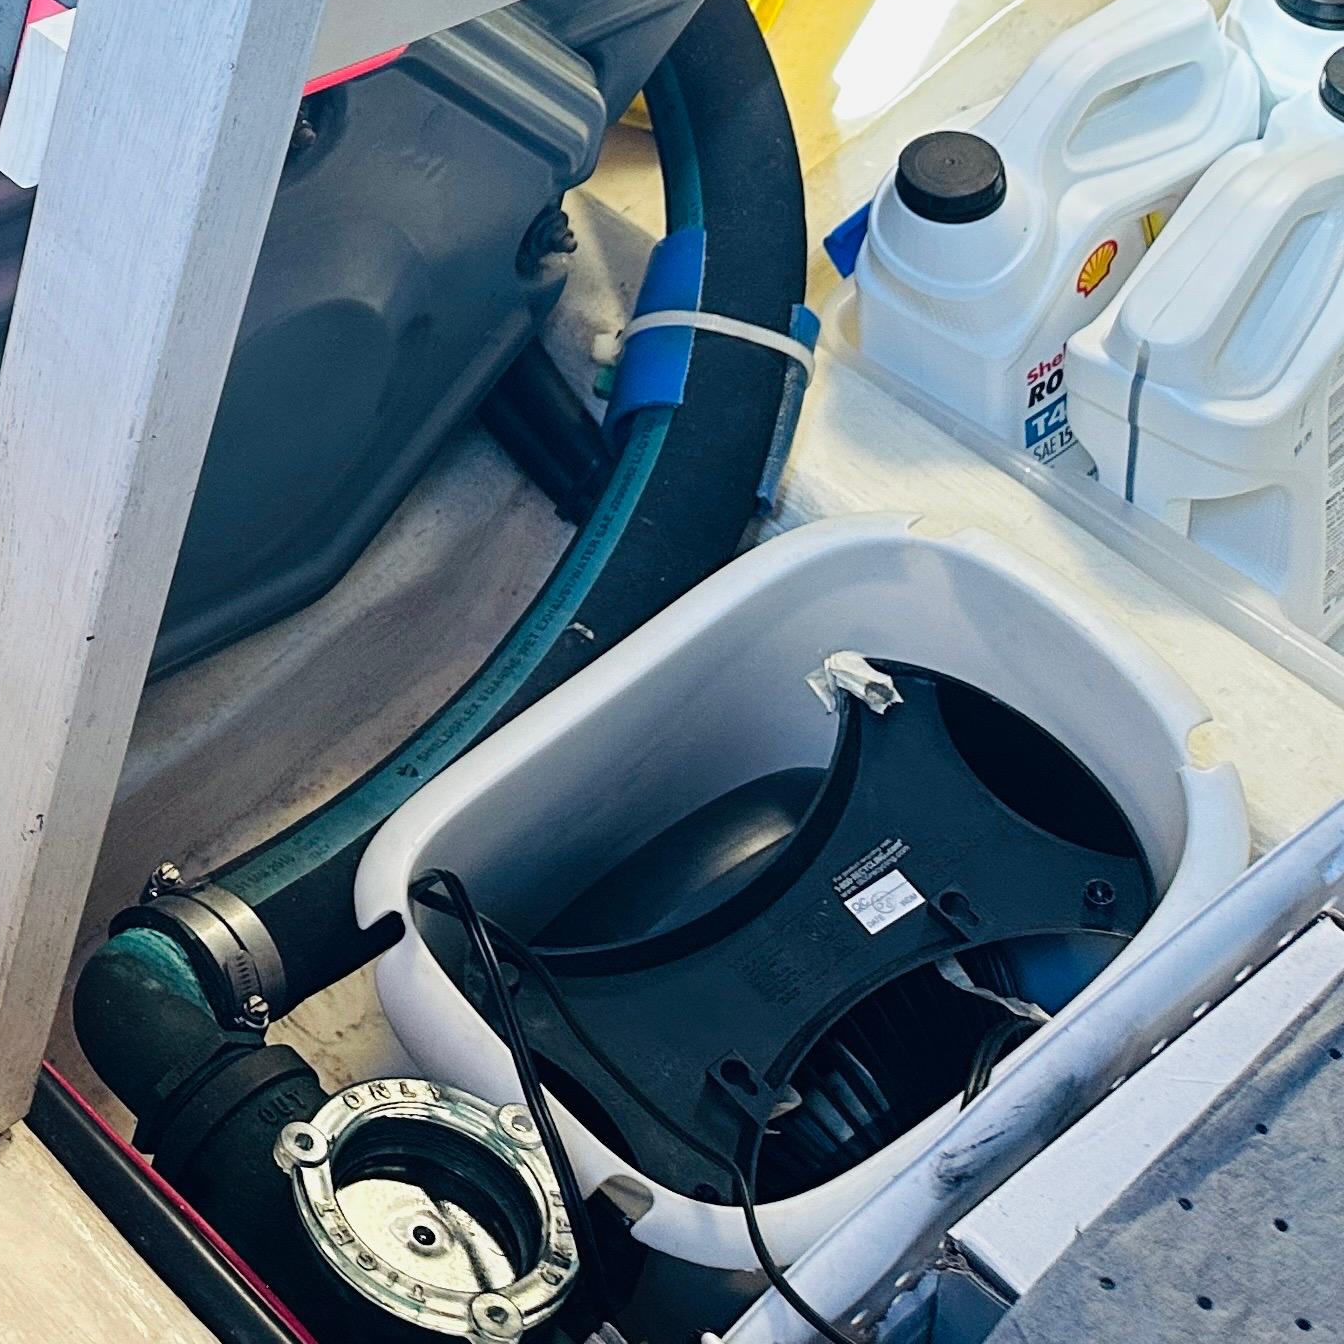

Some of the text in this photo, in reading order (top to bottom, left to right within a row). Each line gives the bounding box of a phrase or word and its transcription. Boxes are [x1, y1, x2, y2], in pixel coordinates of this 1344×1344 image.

[1026, 341, 1068, 386] Shel
[1028, 368, 1064, 408] RO
[1033, 425, 1074, 462] SAE 15
[342, 1081, 442, 1111] ONLY
